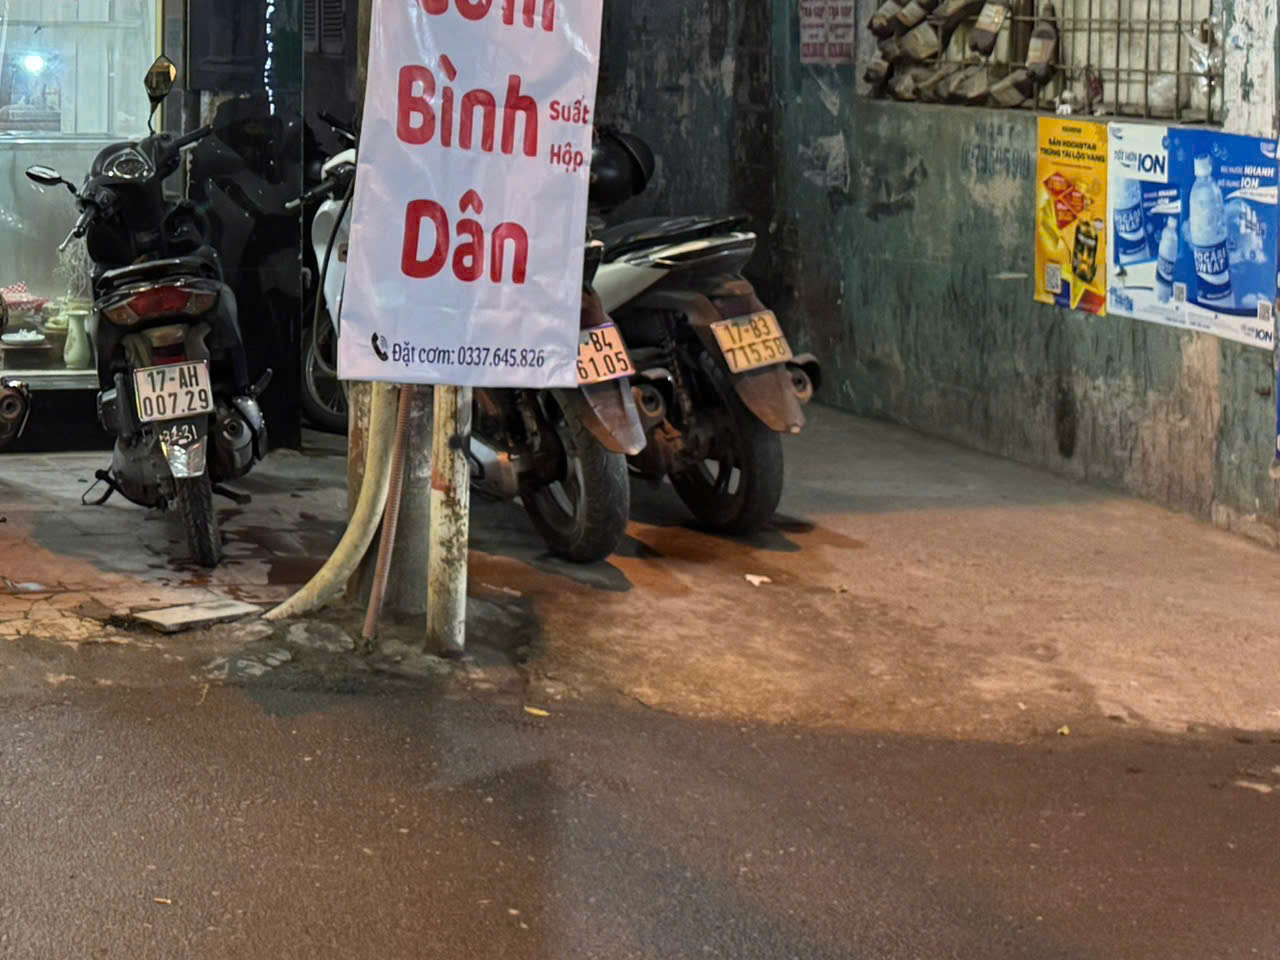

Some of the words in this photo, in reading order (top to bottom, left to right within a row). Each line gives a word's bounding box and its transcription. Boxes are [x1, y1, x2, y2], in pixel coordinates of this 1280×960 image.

[396, 54, 538, 157] Bình
[549, 95, 590, 124] Suất
[549, 141, 584, 173] Hộp
[1137, 153, 1166, 174] ION
[1240, 177, 1259, 189] ION
[1243, 165, 1275, 178] NHANH
[401, 188, 529, 284] Dân
[577, 329, 613, 356] -B4
[723, 316, 770, 346] 17-B3
[1255, 329, 1273, 343] ION
[392, 342, 415, 367] Đặt
[418, 346, 455, 364] cơm:
[457, 346, 545, 367] 0337.645.826
[576, 351, 629, 380] 61.05
[147, 365, 199, 392] 17-AH
[142, 388, 209, 417] 007.29
